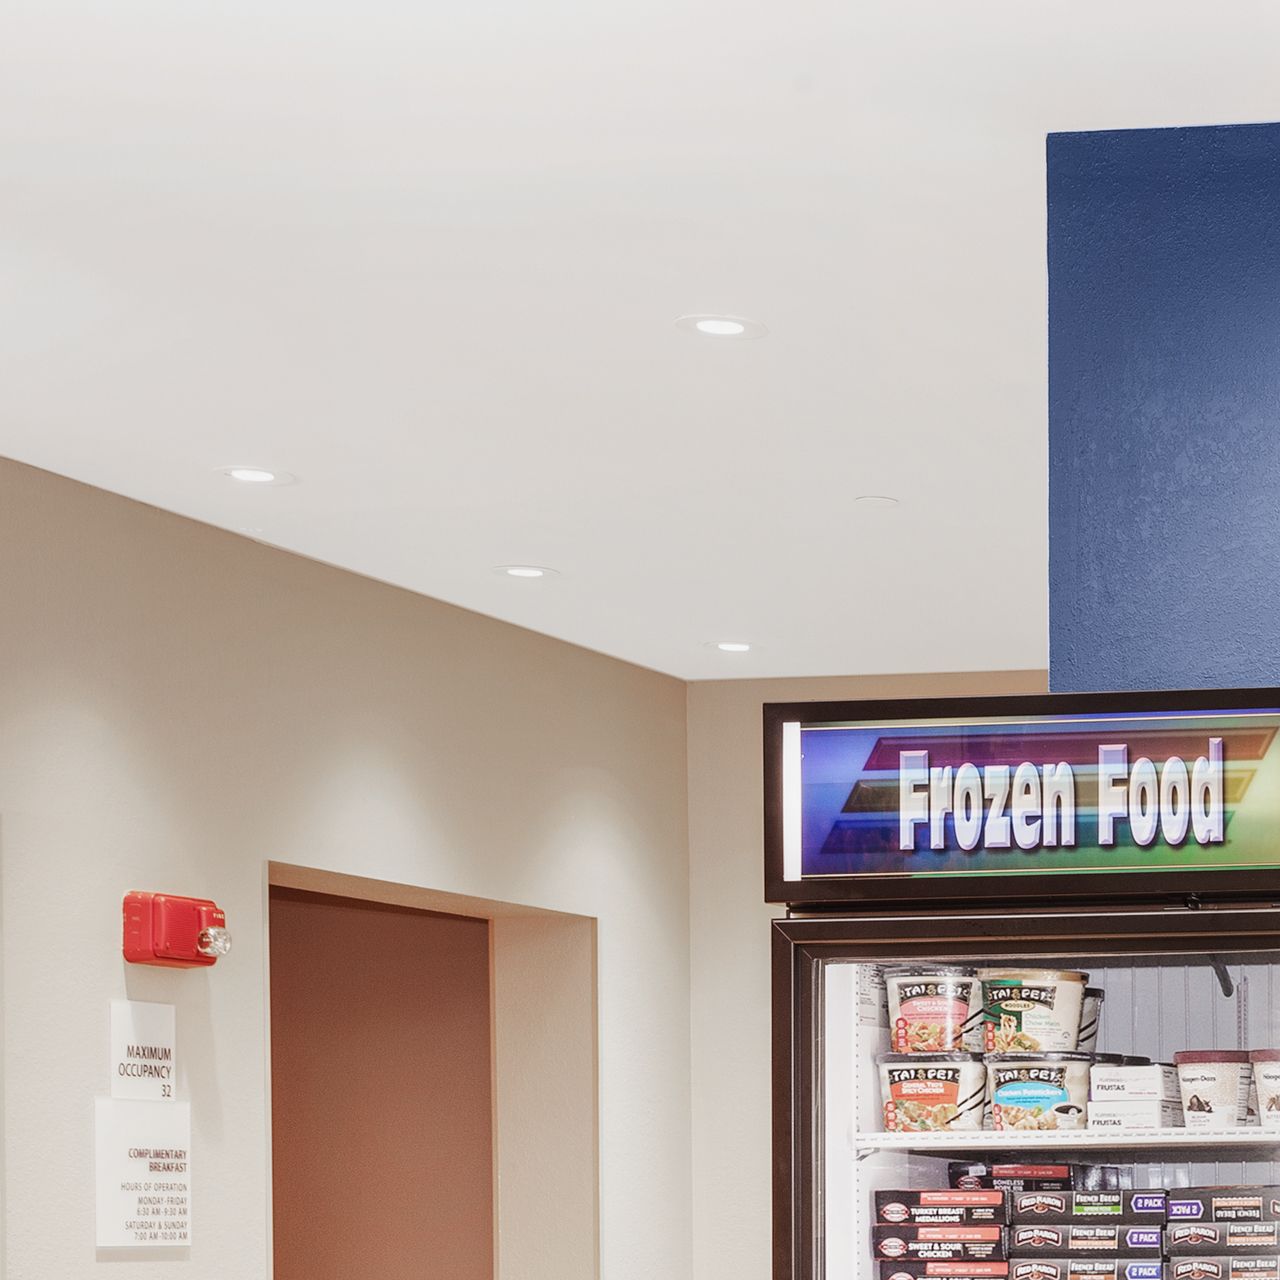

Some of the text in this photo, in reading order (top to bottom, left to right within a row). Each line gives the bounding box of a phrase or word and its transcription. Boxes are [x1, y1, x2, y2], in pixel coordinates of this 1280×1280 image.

[898, 738, 1225, 851] Frozen Food
[127, 1045, 171, 1061] MAXIMUM
[119, 1063, 171, 1079] OCCUPANCY
[162, 1084, 171, 1097] 32
[129, 1149, 186, 1159] COMPLIMENTARY
[149, 1162, 187, 1172] BREAKFAST
[154, 1183, 187, 1191] OPERATION
[1076, 1194, 1120, 1202] FRENCH BREAD
[125, 1221, 155, 1229] SATURDAY
[1071, 1263, 1114, 1271] FRENCH BREAD
